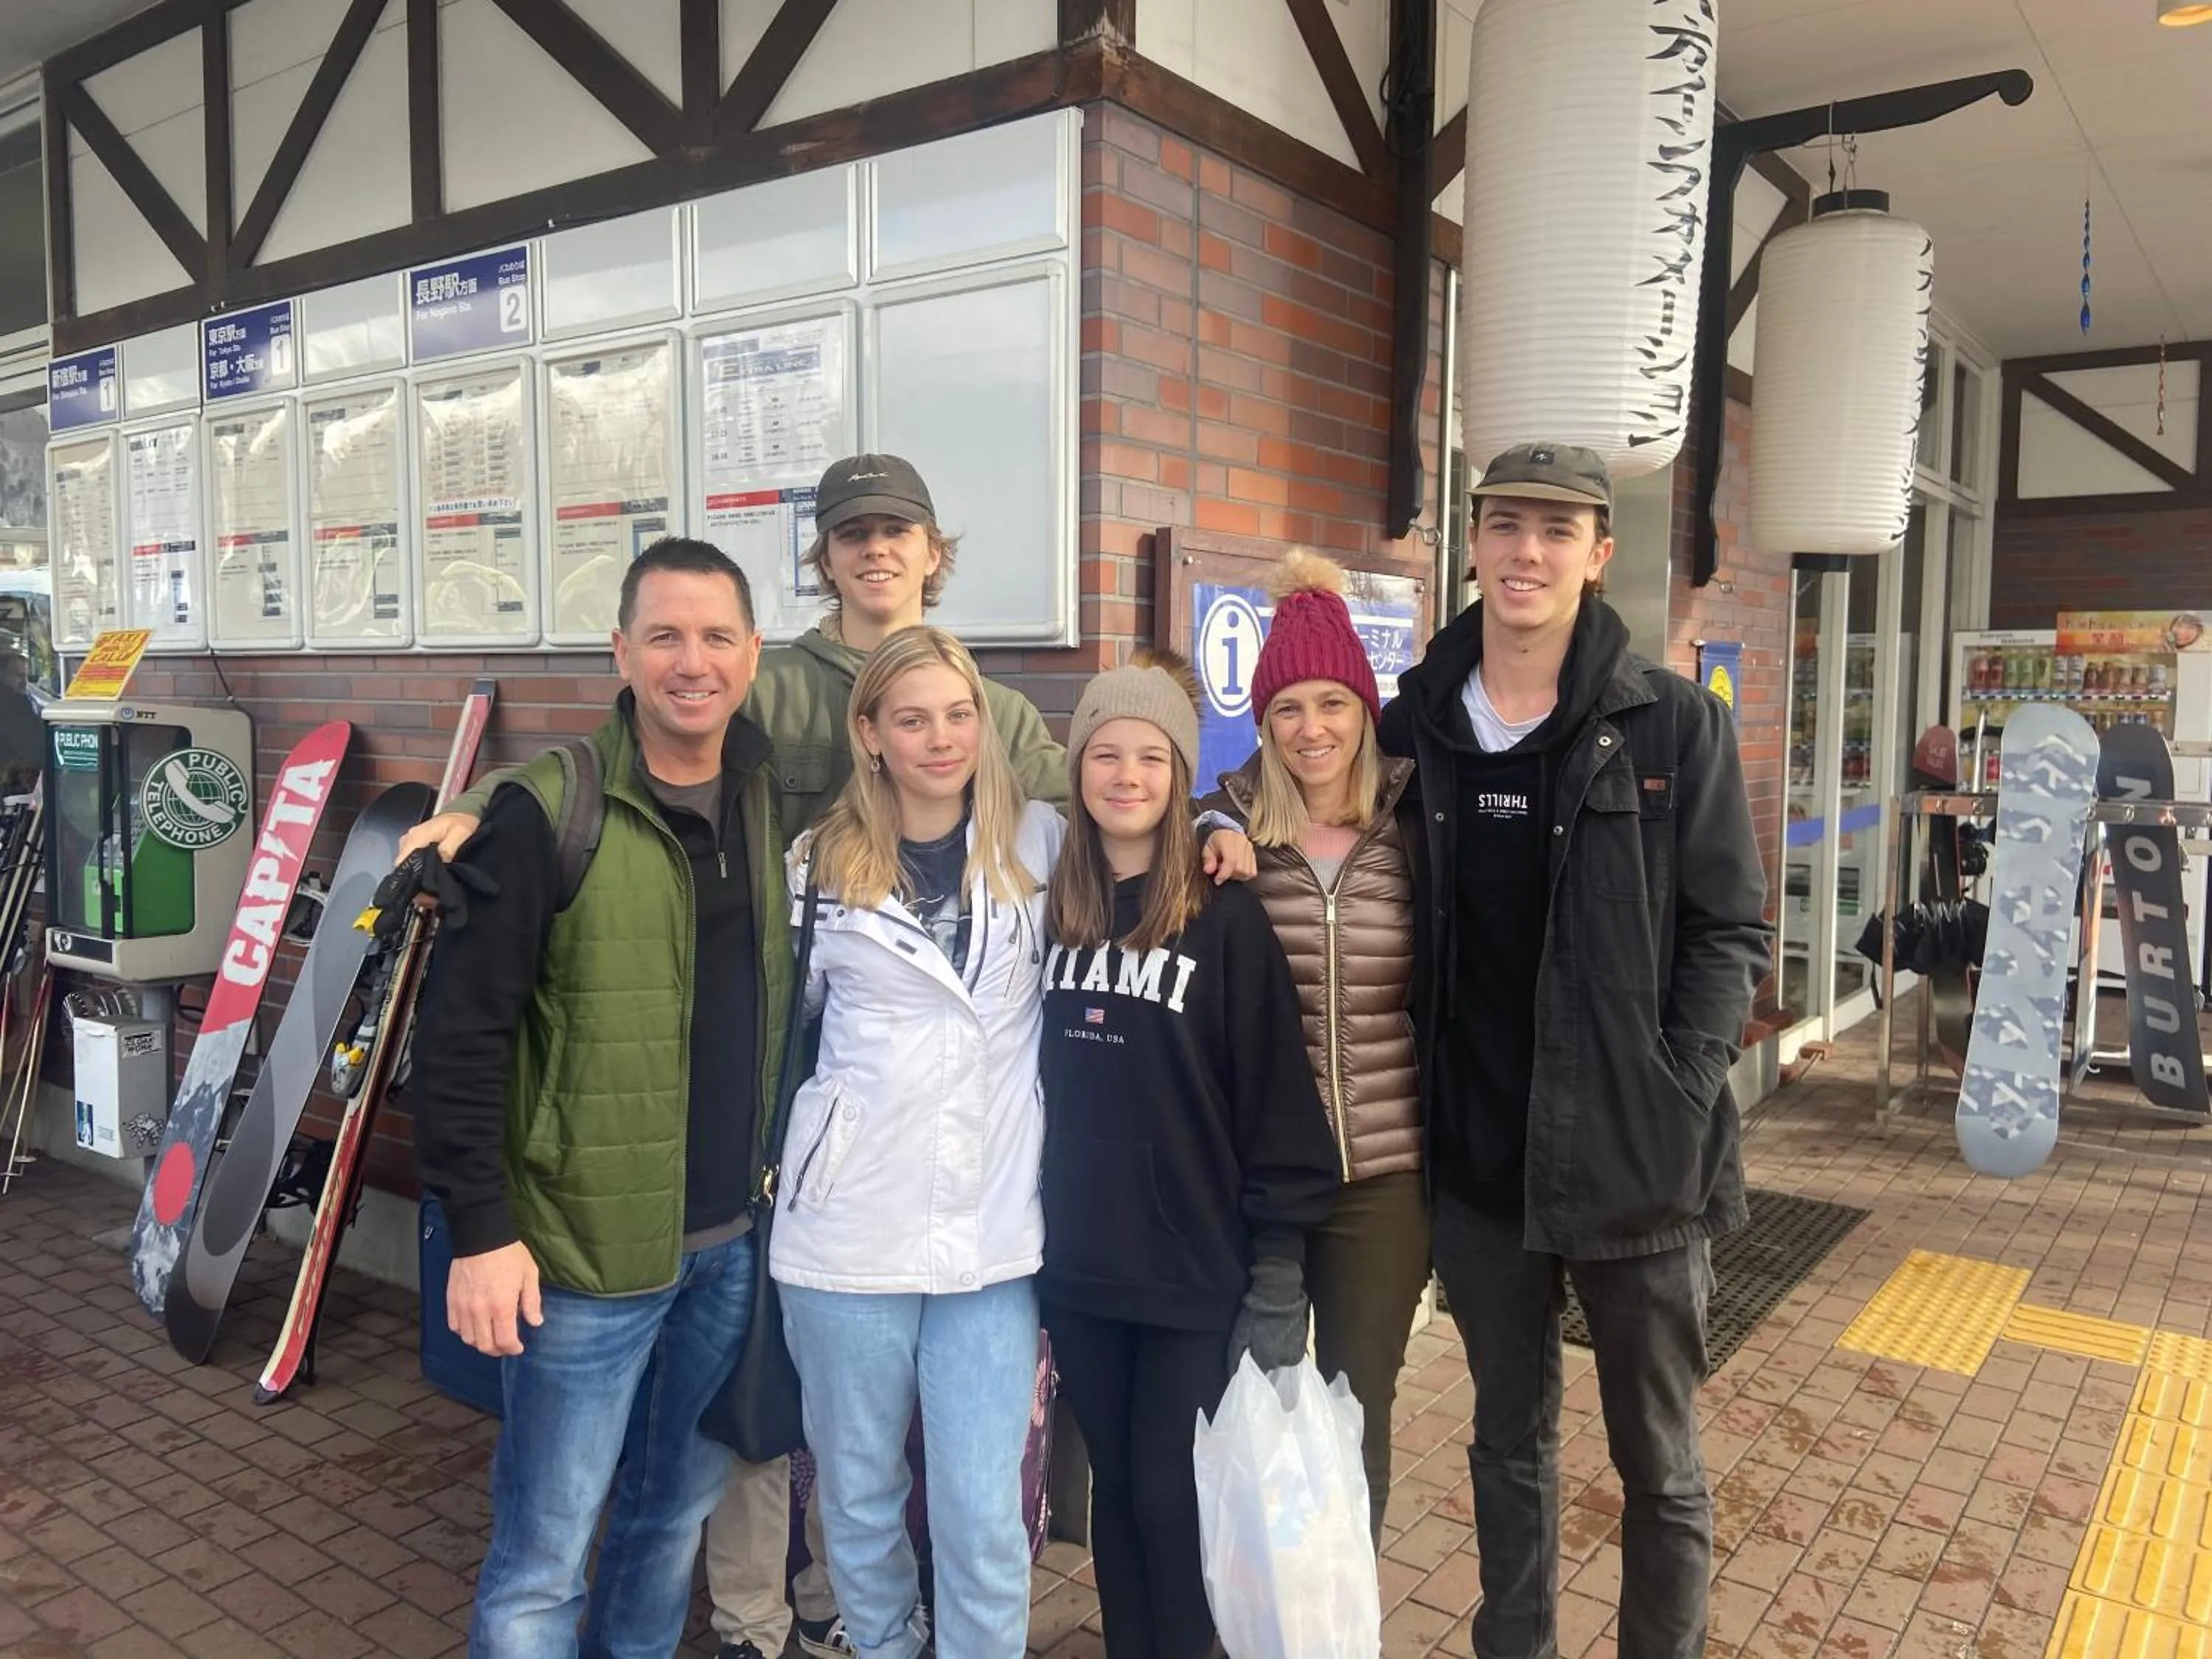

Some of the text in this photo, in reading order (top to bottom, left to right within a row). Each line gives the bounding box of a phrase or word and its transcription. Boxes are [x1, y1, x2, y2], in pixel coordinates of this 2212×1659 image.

[507, 292, 521, 327] 2
[136, 710, 156, 719] NTT
[59, 732, 80, 748] PUBLIC
[189, 753, 243, 803] PUBLIC
[147, 781, 223, 844] TELEPHONE
[1478, 793, 1528, 809] THRILLS
[2115, 775, 2187, 1089] BURTON
[1064, 1028, 1124, 1044] FLORIDA, USA
